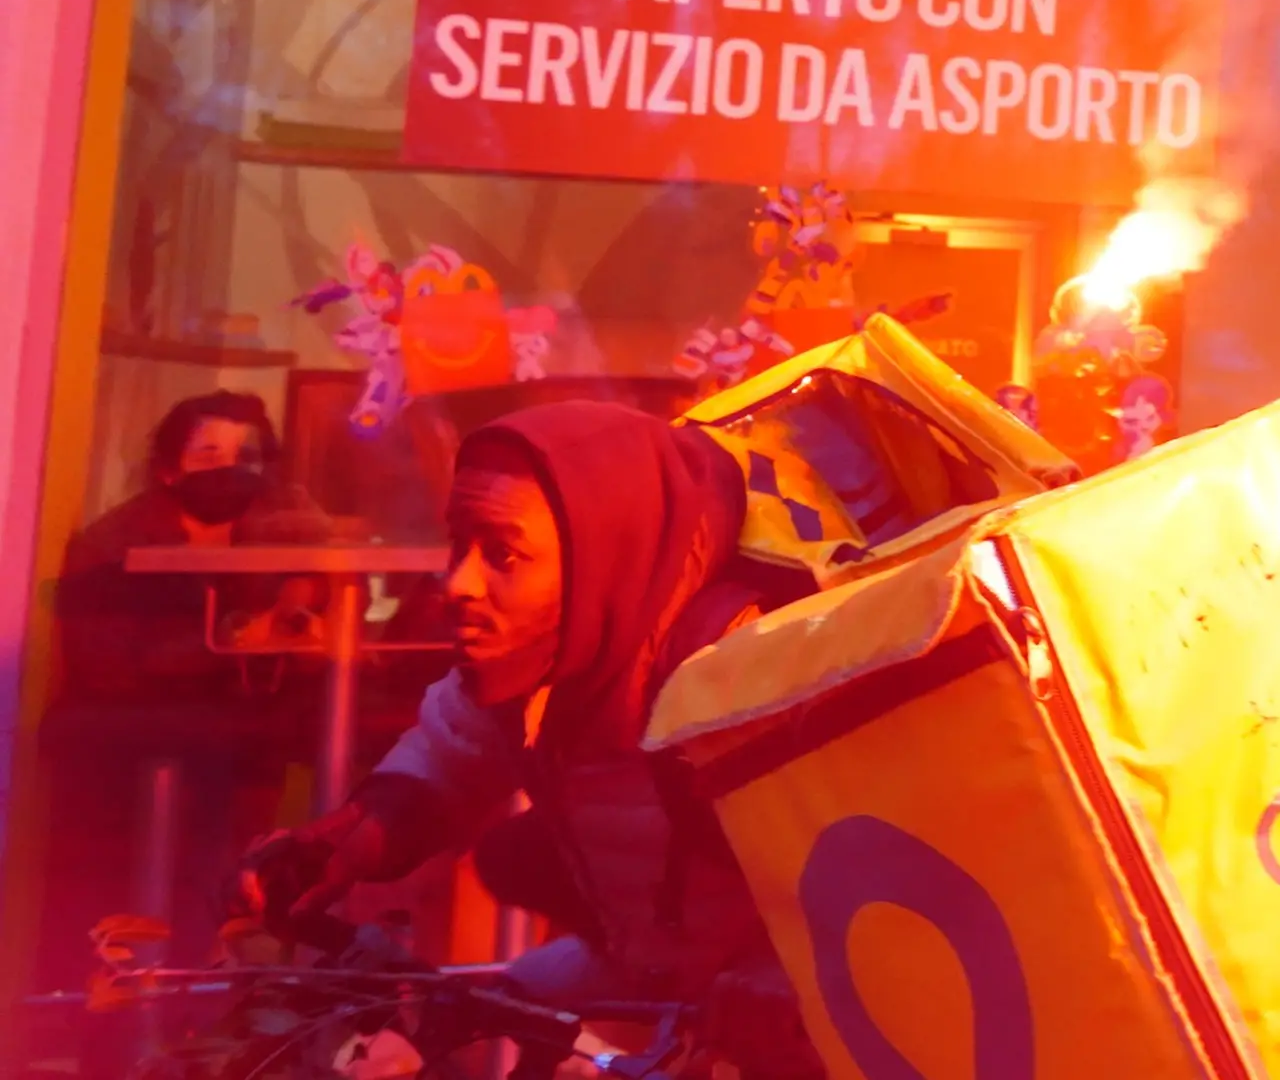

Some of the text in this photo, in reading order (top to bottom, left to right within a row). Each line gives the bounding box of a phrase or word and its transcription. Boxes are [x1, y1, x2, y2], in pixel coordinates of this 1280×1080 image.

[429, 14, 1202, 149] SERVIZIO DA ASPORTO
